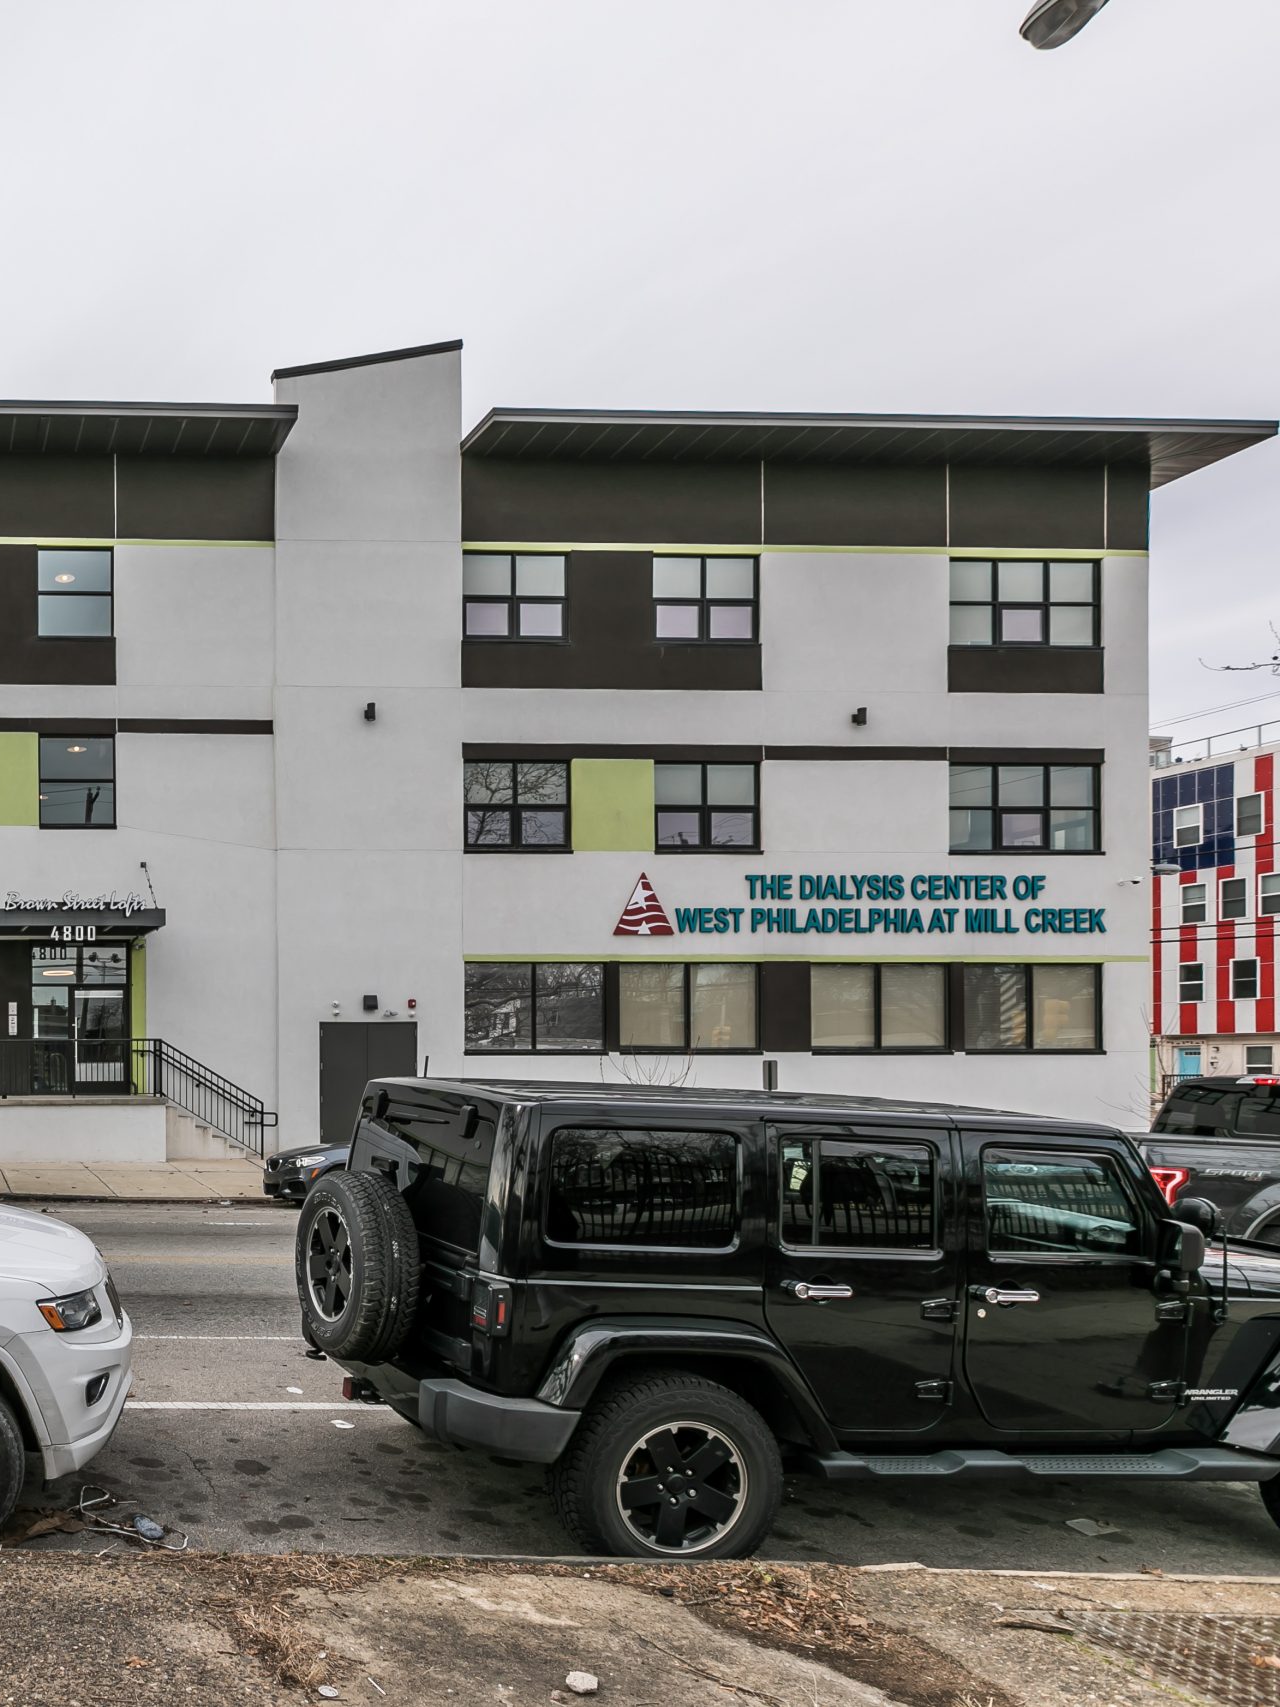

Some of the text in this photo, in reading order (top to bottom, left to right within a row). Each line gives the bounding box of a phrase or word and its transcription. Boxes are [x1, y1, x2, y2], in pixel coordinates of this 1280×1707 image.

[745, 874, 1047, 900] THE DIALYSIS CENTER OF
[5, 890, 146, 918] Brown Street Lofts
[675, 907, 1107, 934] WEST PHILADELPHIA AT MILL CREEK
[50, 925, 97, 942] 4800
[1199, 1168, 1272, 1178] SPORT
[1184, 1388, 1239, 1396] WRANGLER
